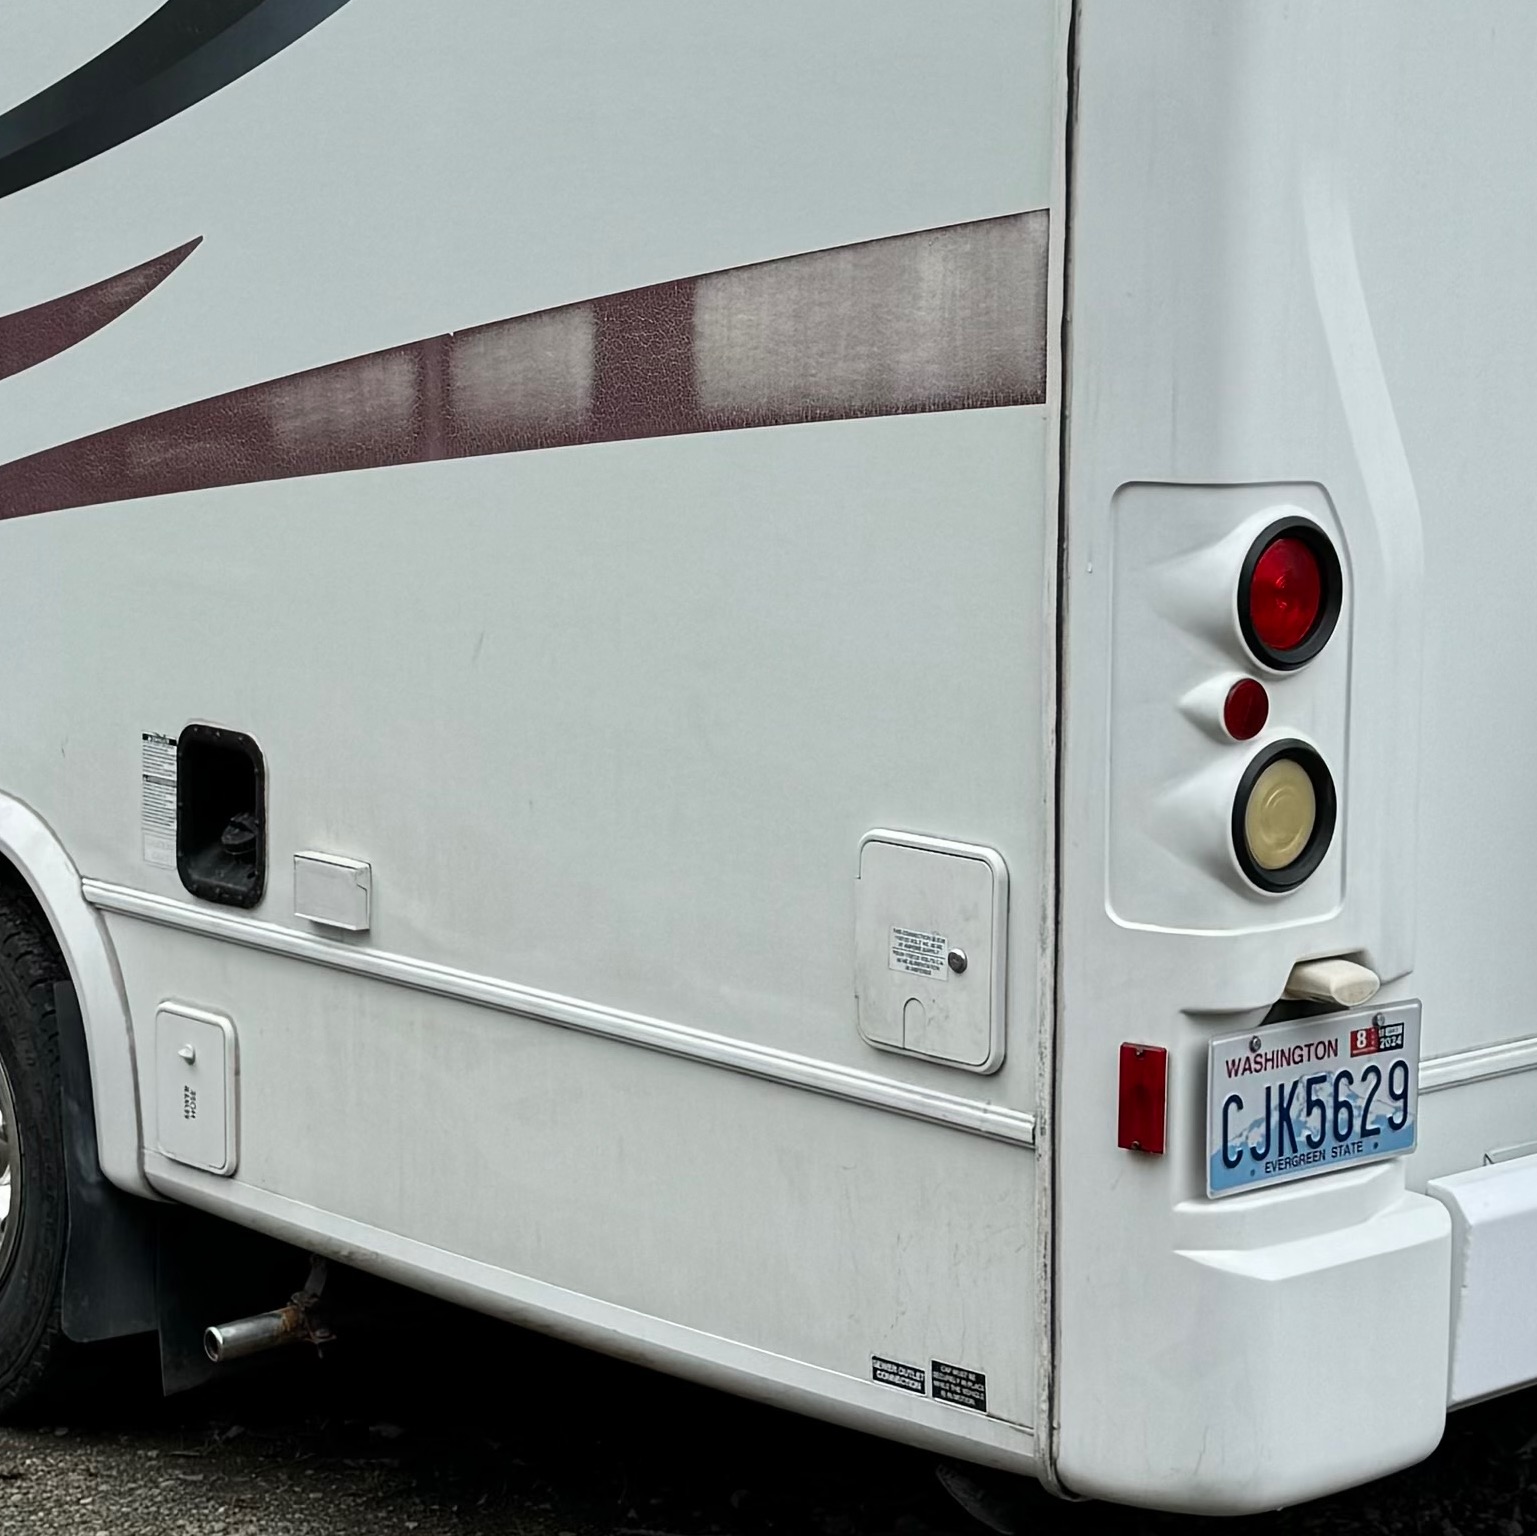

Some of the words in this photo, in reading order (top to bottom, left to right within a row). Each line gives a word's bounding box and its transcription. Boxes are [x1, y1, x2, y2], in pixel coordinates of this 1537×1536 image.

[1356, 1029, 1367, 1049] 8
[1225, 1038, 1339, 1079] WASHINGTON
[1222, 1059, 1410, 1169] CJK5629
[1264, 1149, 1326, 1174] EVERGREEN
[1331, 1141, 1364, 1158] STATE
